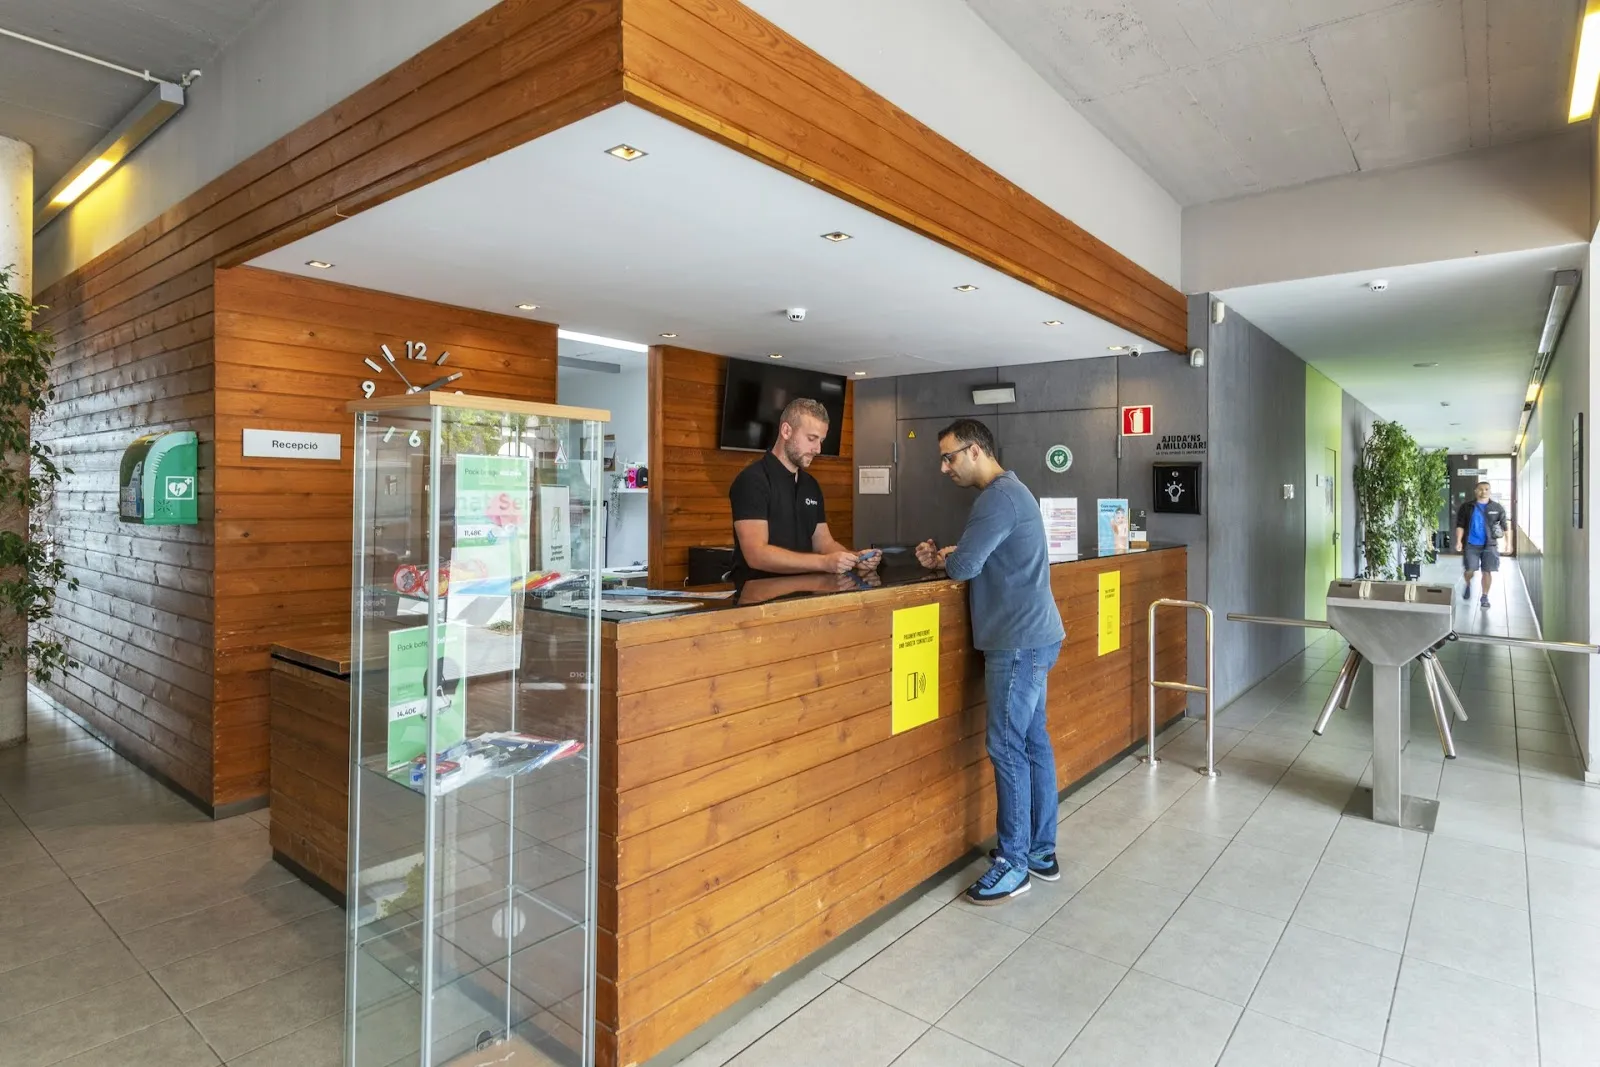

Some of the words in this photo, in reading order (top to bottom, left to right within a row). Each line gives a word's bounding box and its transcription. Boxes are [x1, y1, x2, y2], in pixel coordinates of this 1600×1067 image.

[406, 341, 427, 361] 12
[361, 380, 376, 399] 9
[408, 430, 421, 447] 6
[1161, 434, 1201, 443] AJUDA'NS
[272, 440, 318, 451] Recepció
[1163, 441, 1207, 450] MILLORAR!
[397, 642, 413, 652] Pack
